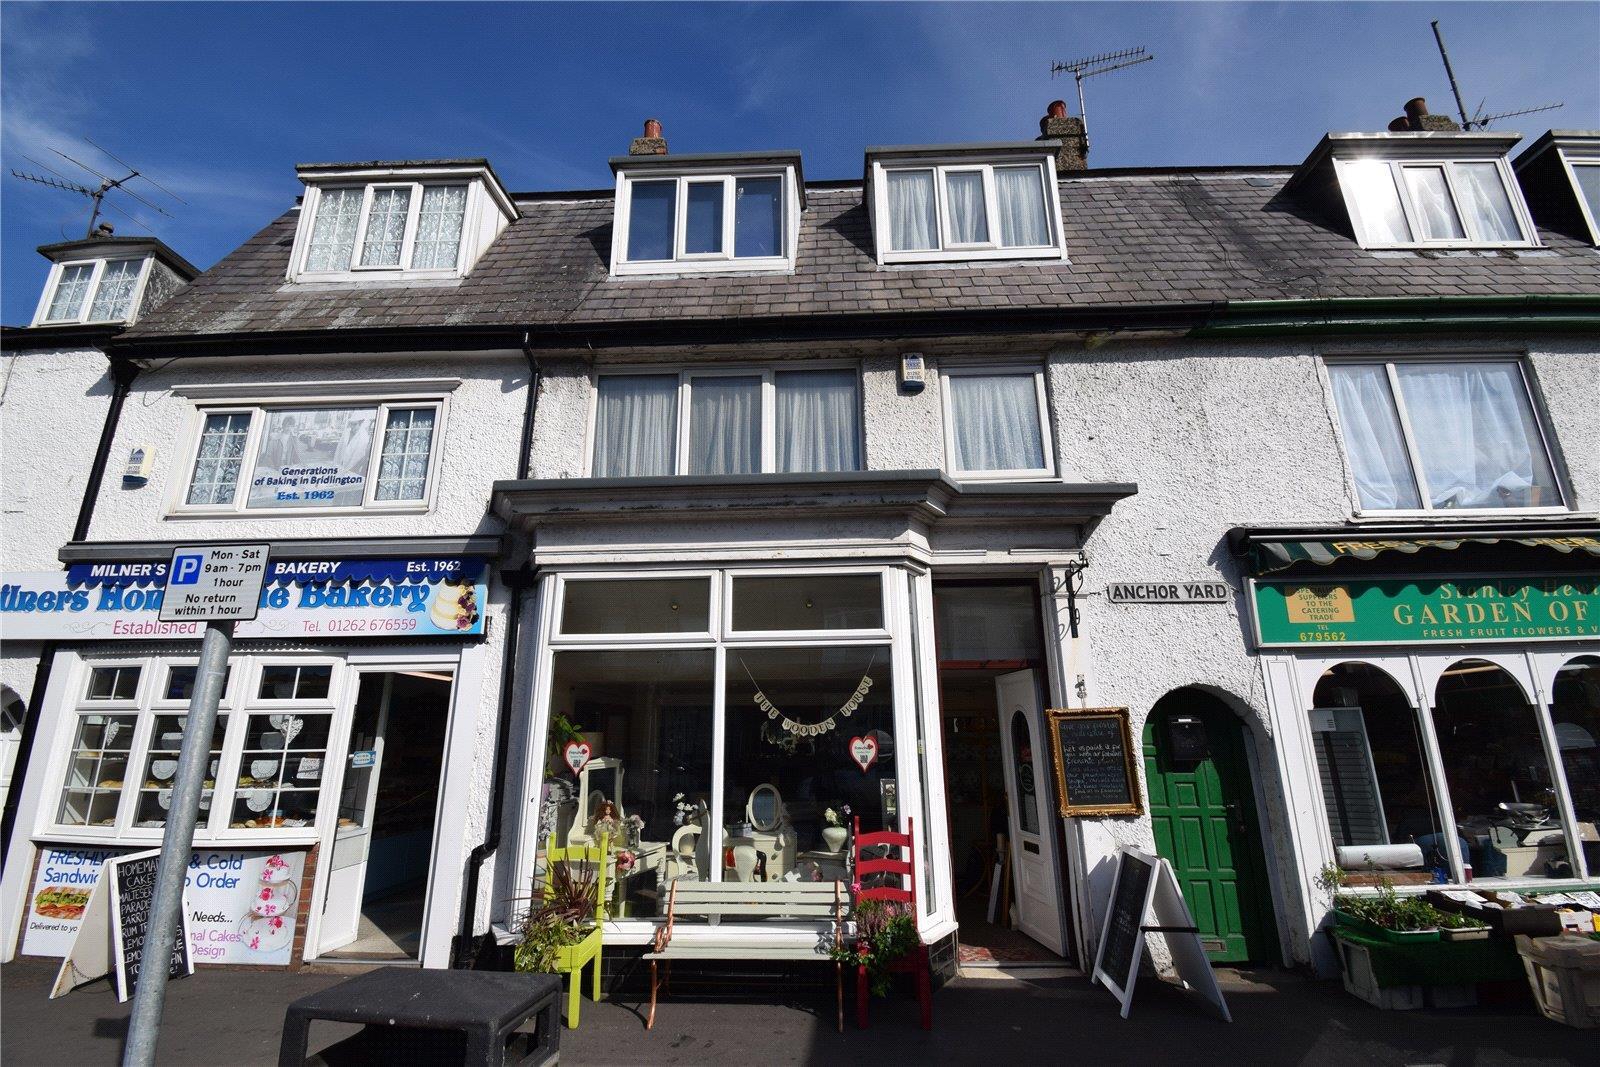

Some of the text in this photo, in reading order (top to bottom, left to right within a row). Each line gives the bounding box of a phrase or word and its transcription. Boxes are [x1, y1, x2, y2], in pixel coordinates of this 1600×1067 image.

[281, 466, 339, 476] Generations
[254, 475, 362, 486] of Baking in Bridlington
[277, 490, 335, 501] Est. 1962
[210, 550, 233, 560] Mon
[241, 549, 261, 559] Sat
[90, 563, 166, 577] MILNER'S
[274, 561, 341, 574] BAKERY
[406, 560, 461, 573] Est. 1962
[0, 583, 90, 612] ilners
[184, 594, 236, 603] No return
[297, 582, 431, 612] Bakery
[1112, 584, 1227, 600] ANCHOR YARD
[1298, 593, 1338, 601] SUPPLIERS
[174, 605, 242, 616] within 1 hour
[1393, 600, 1588, 625] GARDEN OF
[113, 620, 197, 635] Established
[302, 618, 417, 632] Tel. 01262 676559
[1423, 628, 1463, 638] FRESH
[1470, 627, 1506, 637] FRUIT
[1513, 626, 1571, 636] FLOWERS
[1577, 625, 1585, 634] &
[1299, 632, 1346, 641] 679562
[782, 718, 835, 736] WOODEN
[47, 850, 111, 866] FRESHLY
[189, 854, 244, 870] & Cold
[196, 872, 241, 889] Order
[192, 911, 233, 923] Needs...
[29, 922, 61, 931] Delivered
[68, 925, 78, 933] yo
[121, 925, 138, 938] RUM
[123, 935, 145, 951] LEMO
[208, 930, 243, 943] Cakes
[124, 948, 144, 964] LEMO
